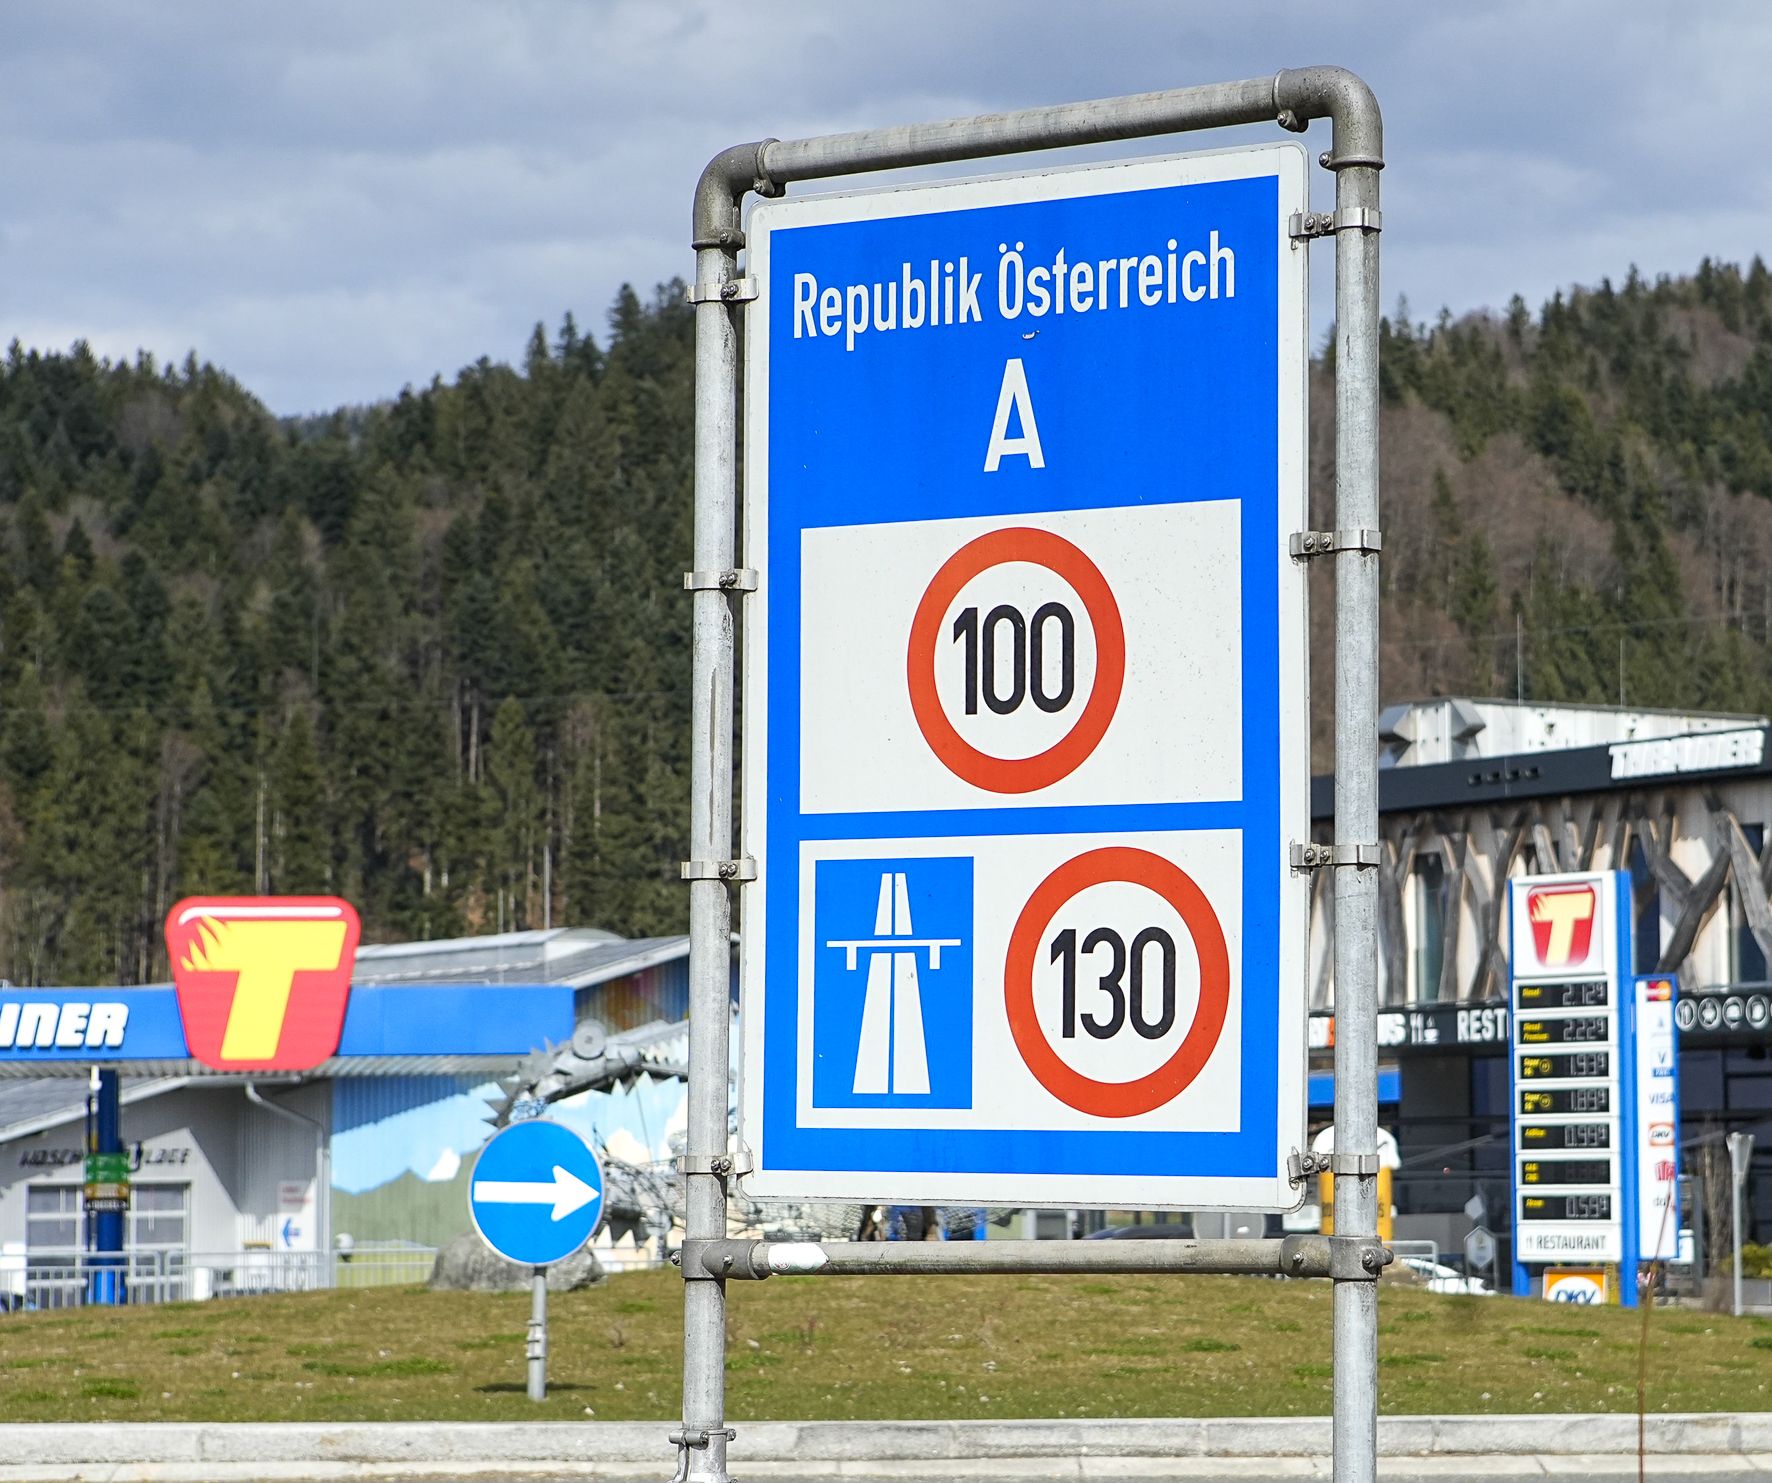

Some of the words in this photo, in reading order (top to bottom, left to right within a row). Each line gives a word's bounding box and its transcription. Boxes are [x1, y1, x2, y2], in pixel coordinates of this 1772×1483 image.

[794, 257, 982, 351] Republik
[999, 231, 1234, 319] Österreich
[984, 359, 1045, 471] A
[954, 602, 1074, 715] 100
[1051, 927, 1175, 1039] 130
[1457, 1008, 1509, 1042] REST
[1536, 1234, 1606, 1250] RESTAURANT
